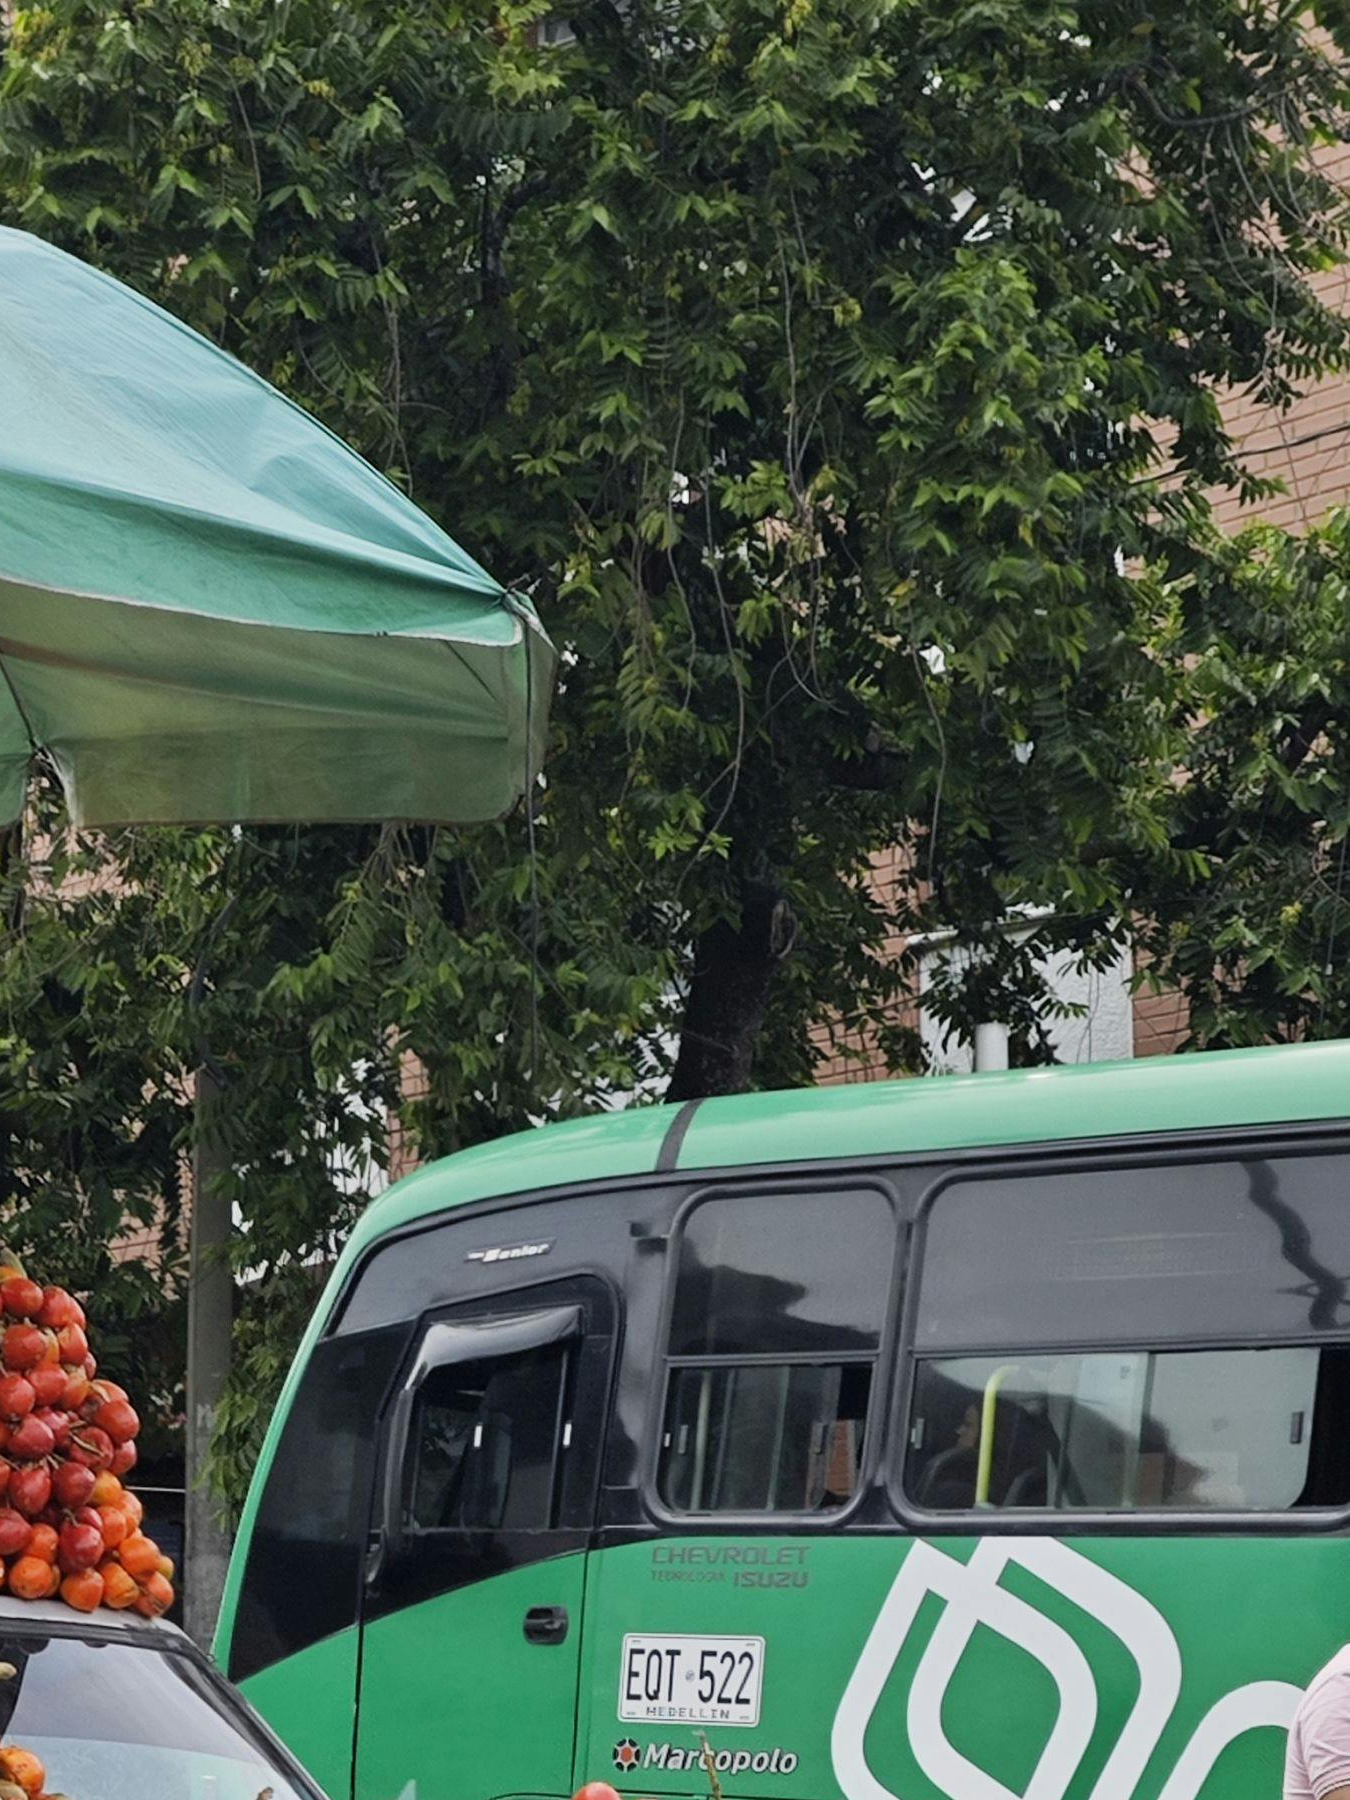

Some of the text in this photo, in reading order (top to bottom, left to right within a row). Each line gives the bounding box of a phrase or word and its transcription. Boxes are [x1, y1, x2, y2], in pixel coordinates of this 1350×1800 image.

[652, 1546, 811, 1565] CHEVROLET
[733, 1571, 809, 1588] ISUZU
[626, 1648, 754, 1705] EQT 522
[646, 1706, 730, 1719] MEDELLIN
[643, 1743, 798, 1775] Marcopolo
